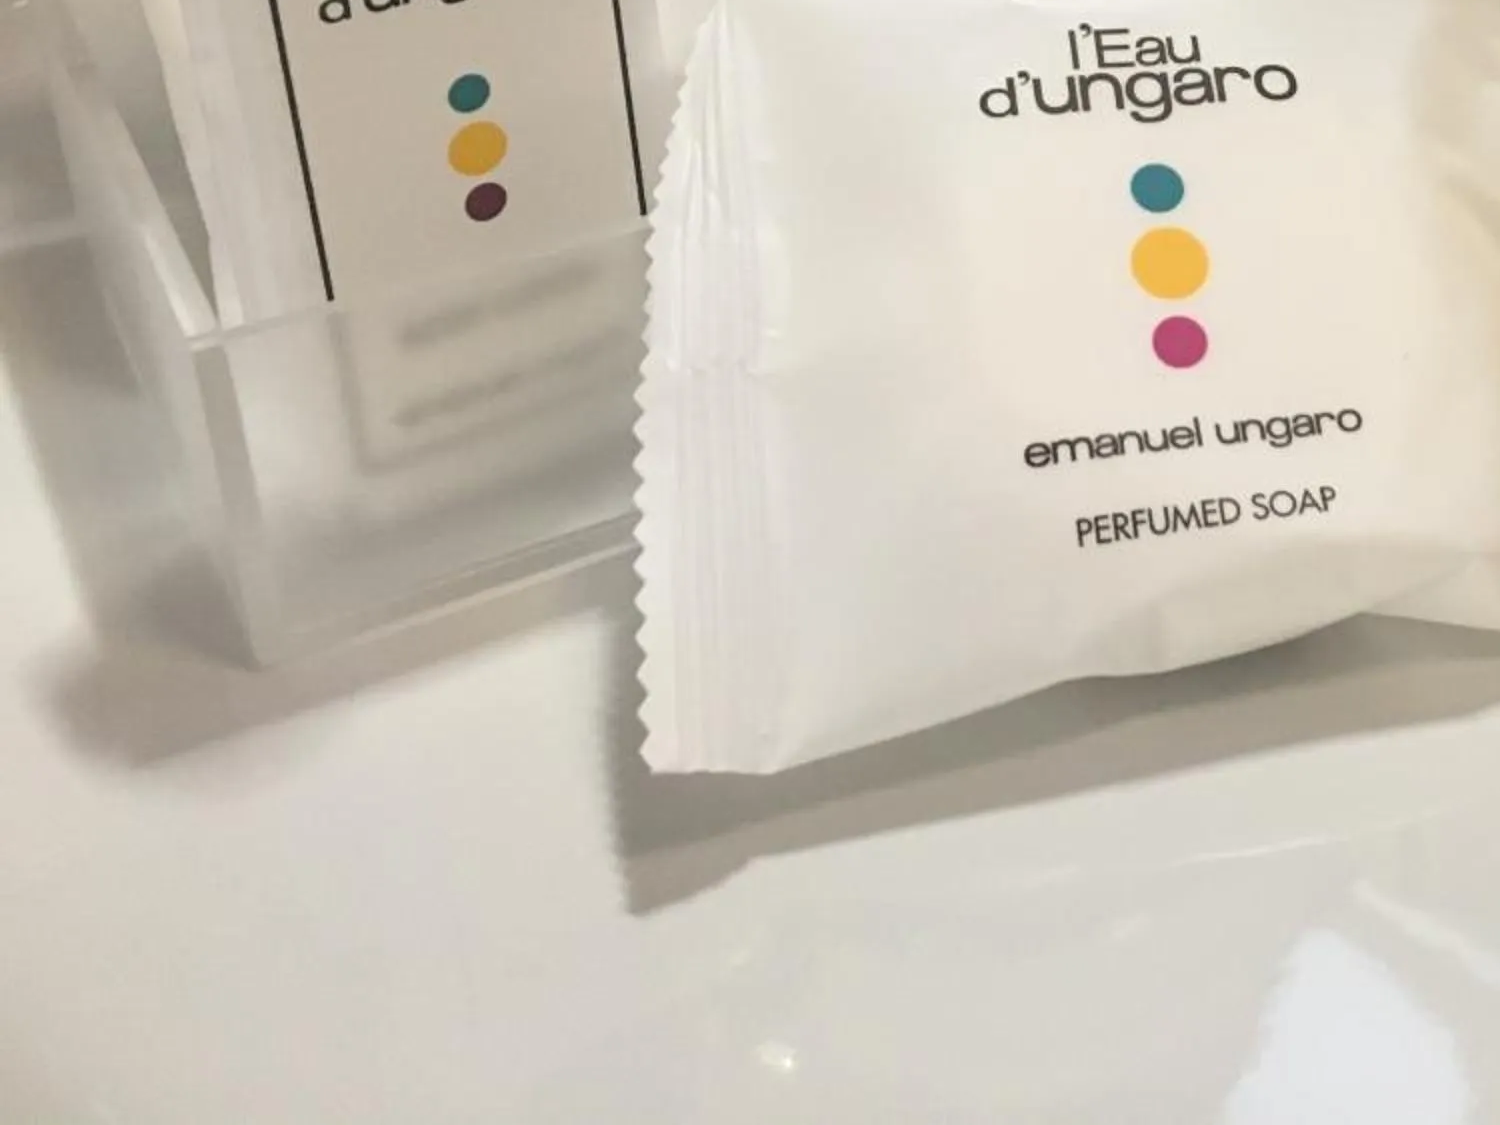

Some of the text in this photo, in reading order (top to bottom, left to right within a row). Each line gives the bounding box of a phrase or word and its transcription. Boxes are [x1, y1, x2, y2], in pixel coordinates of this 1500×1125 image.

[1023, 408, 1363, 469] emanuel ungaro
[1075, 486, 1337, 548] PERFUMED SOAP
